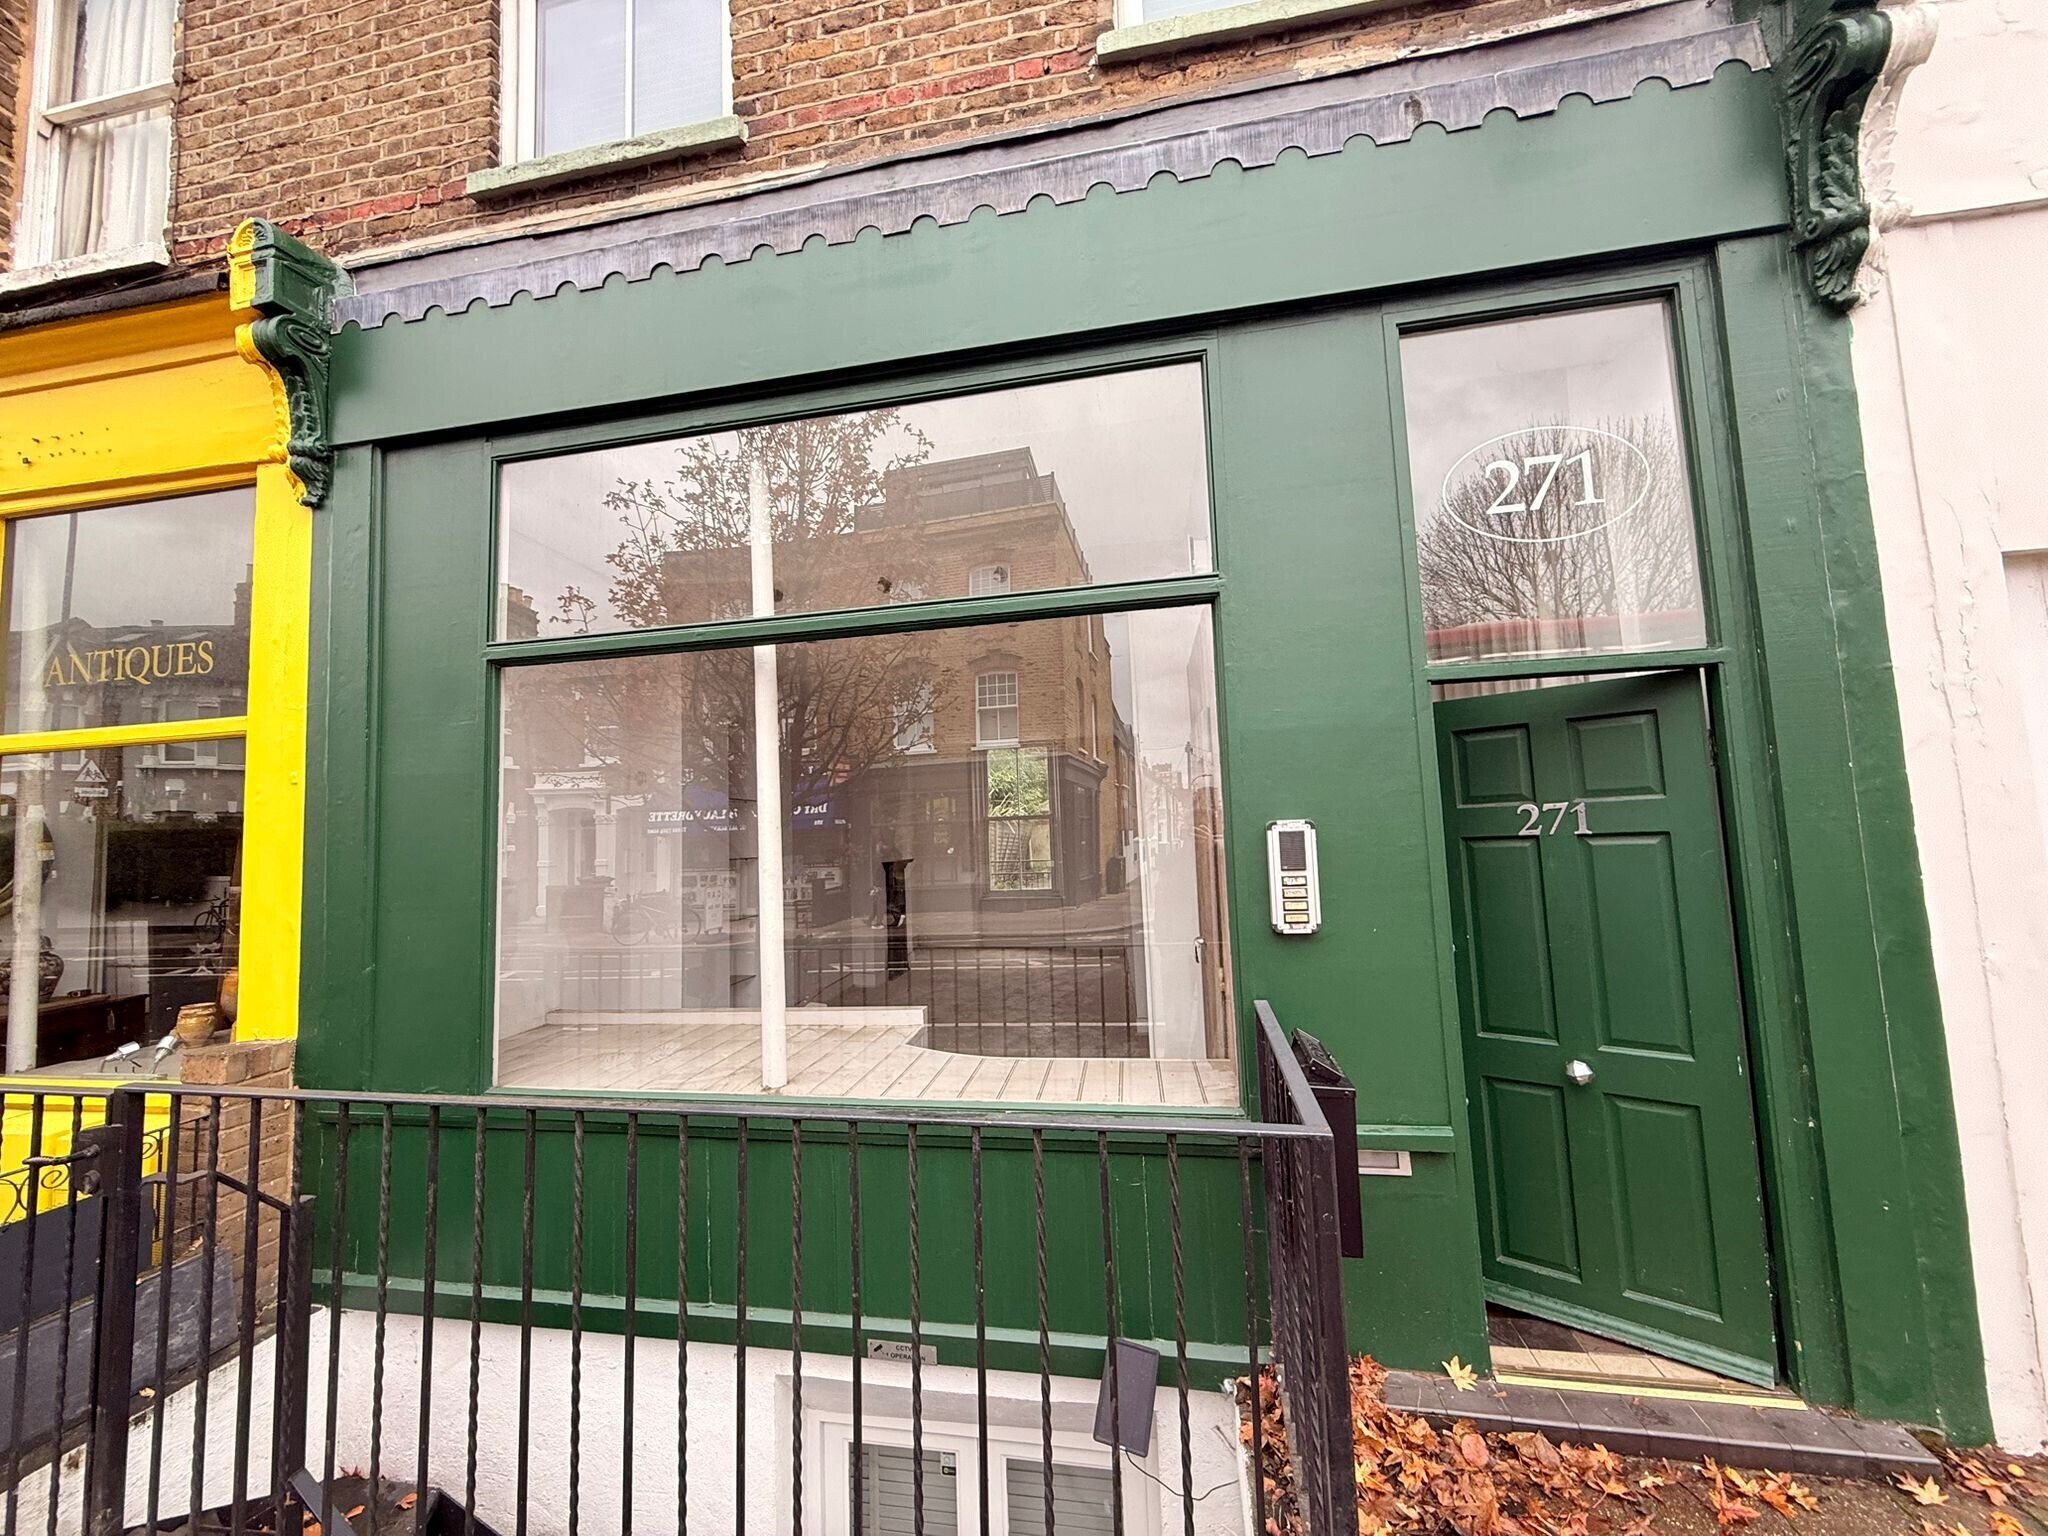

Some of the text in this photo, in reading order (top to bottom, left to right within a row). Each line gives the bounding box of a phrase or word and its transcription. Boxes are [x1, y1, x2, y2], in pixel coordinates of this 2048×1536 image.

[1484, 449, 1605, 515] 271
[44, 640, 215, 687] ANTIQUES
[1516, 801, 1593, 836] 271
[890, 1353, 926, 1362] OPERAN
